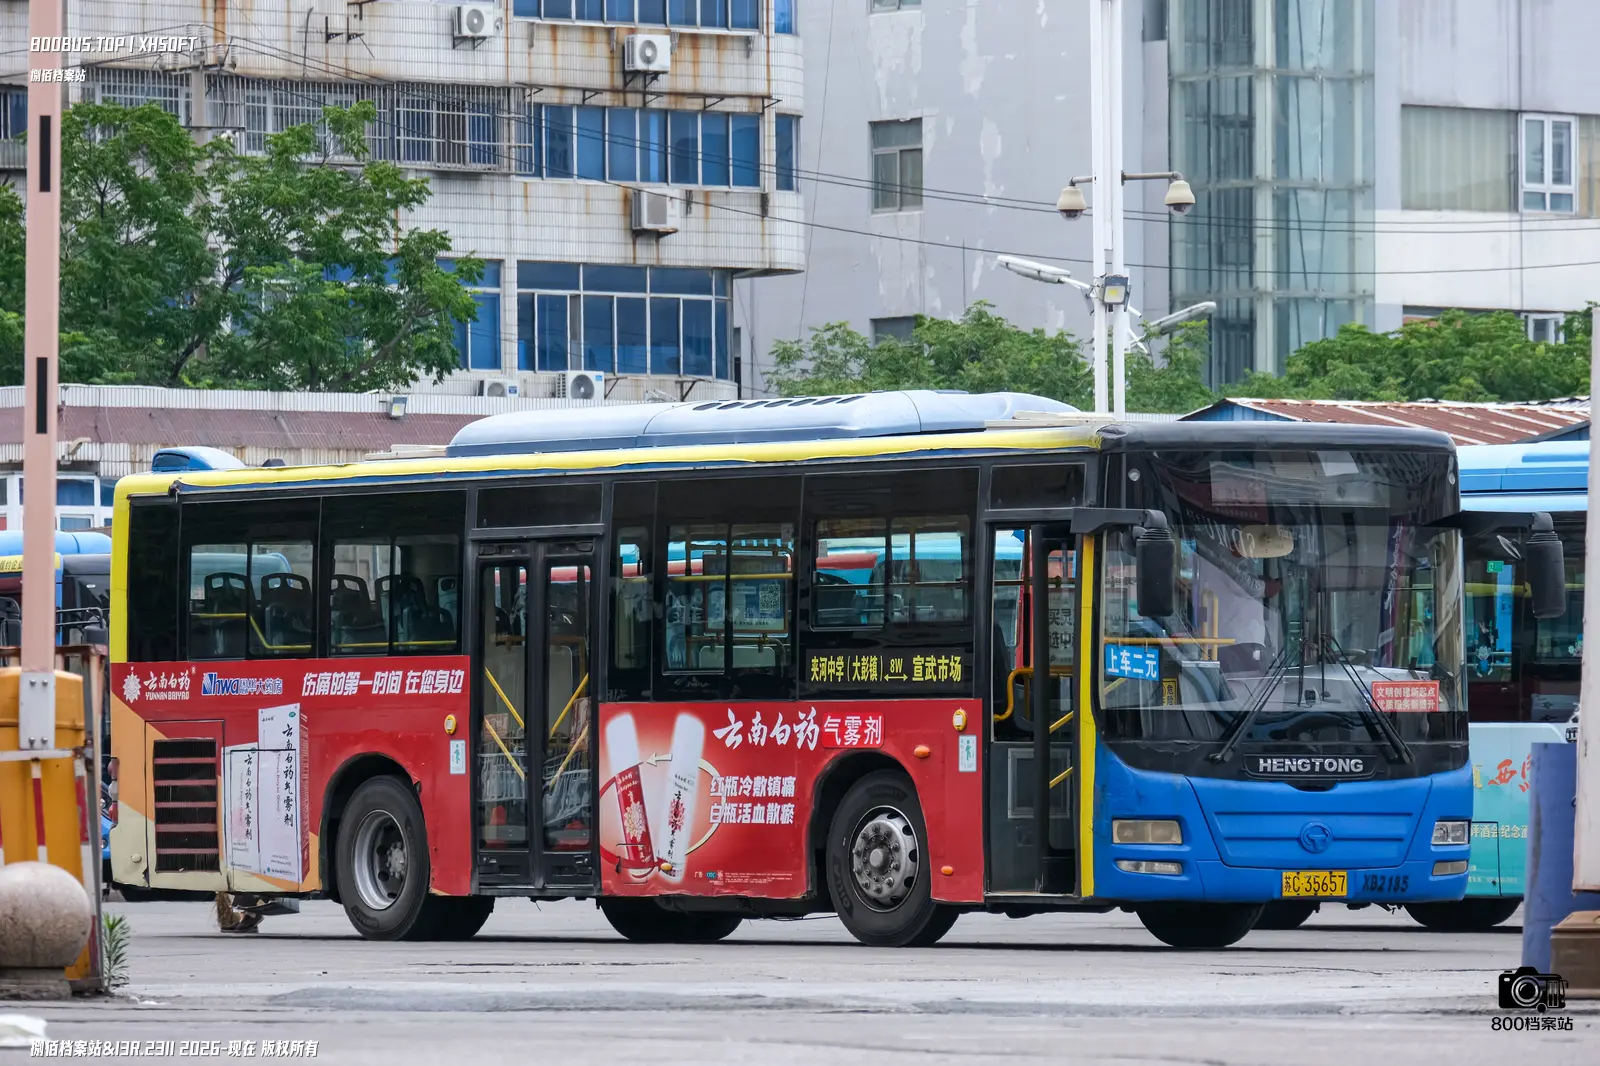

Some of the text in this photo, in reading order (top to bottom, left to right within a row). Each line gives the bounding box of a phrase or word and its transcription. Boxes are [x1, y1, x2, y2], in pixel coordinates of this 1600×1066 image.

[890, 658, 903, 673] 8W
[912, 655, 961, 683] 宣武市场
[1108, 649, 1157, 678] 上车二元
[143, 670, 190, 692] 云南白药
[302, 670, 465, 696] 伤痛的第一时间 在您身边
[713, 706, 883, 751] 云南白药 气雾剂
[1258, 758, 1364, 773] HENGTONG
[709, 775, 797, 798] 红瓶冷敷镇痛
[709, 802, 795, 825] 白瓶活血散瘀
